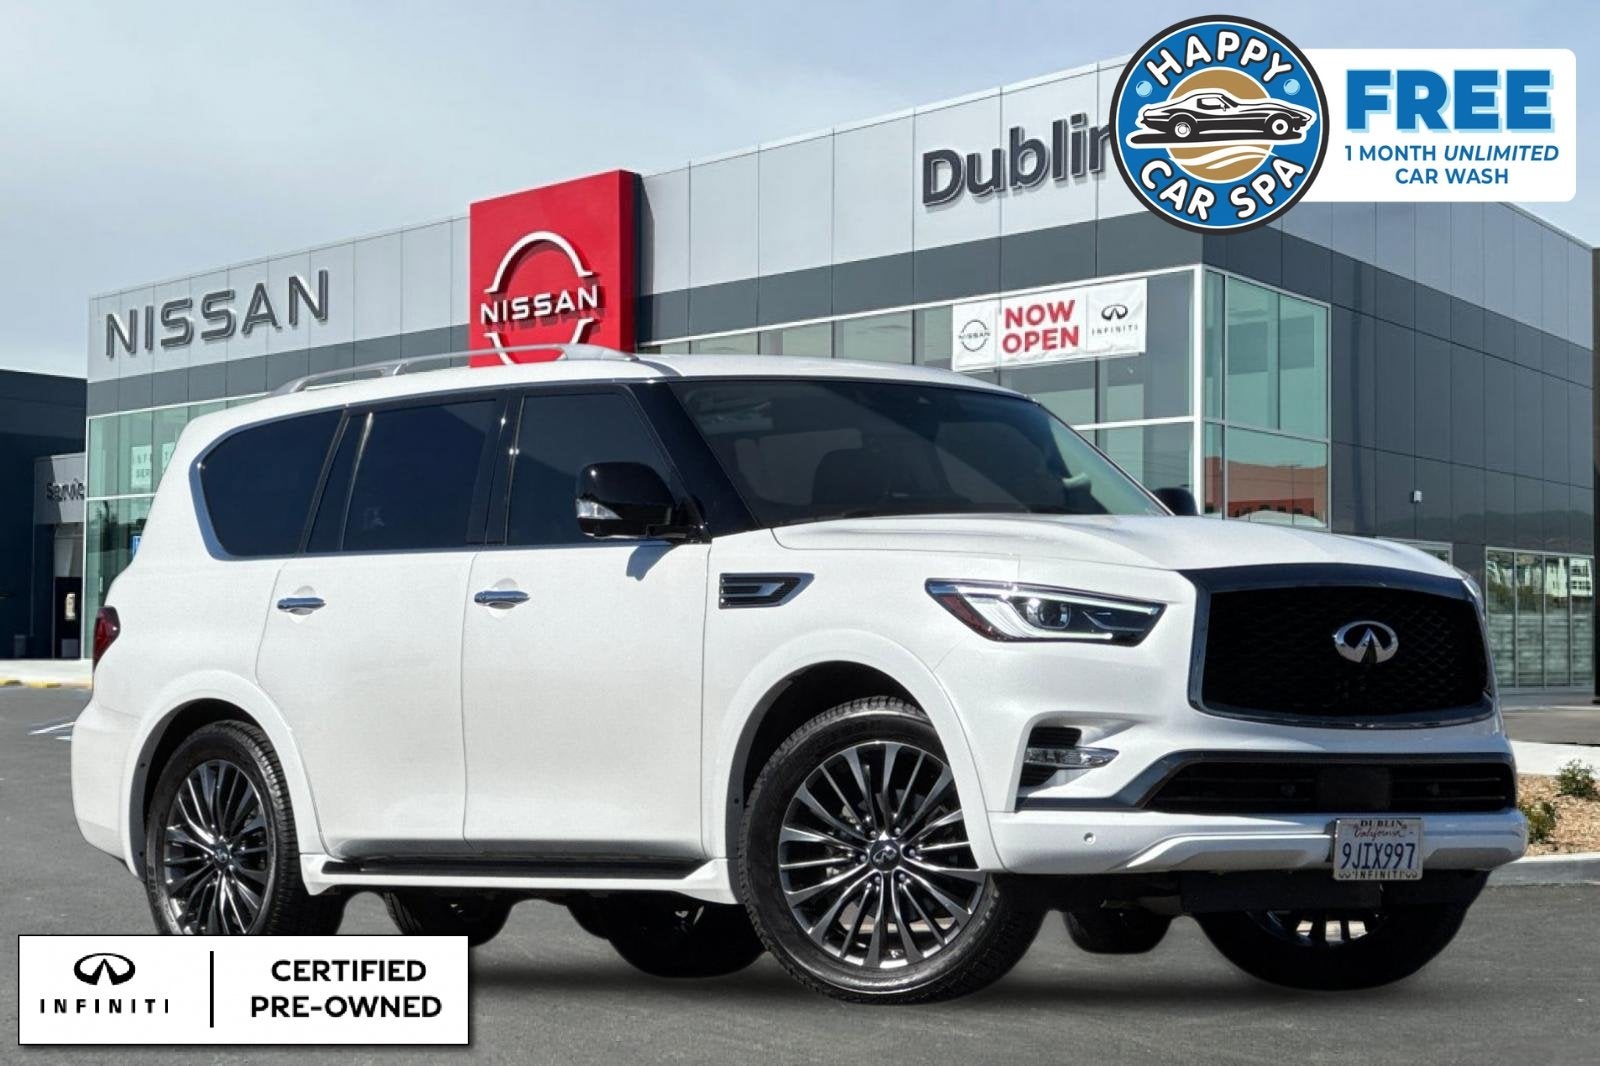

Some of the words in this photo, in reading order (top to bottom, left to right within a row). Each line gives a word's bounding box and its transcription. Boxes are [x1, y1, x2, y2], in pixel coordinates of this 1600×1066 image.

[105, 269, 329, 358] NISSAN
[480, 285, 599, 325] NISSAN
[1005, 300, 1075, 329] NOW
[1002, 326, 1079, 354] OPEN
[1092, 324, 1139, 336] INFINITI
[1341, 842, 1416, 869] 9JIX997
